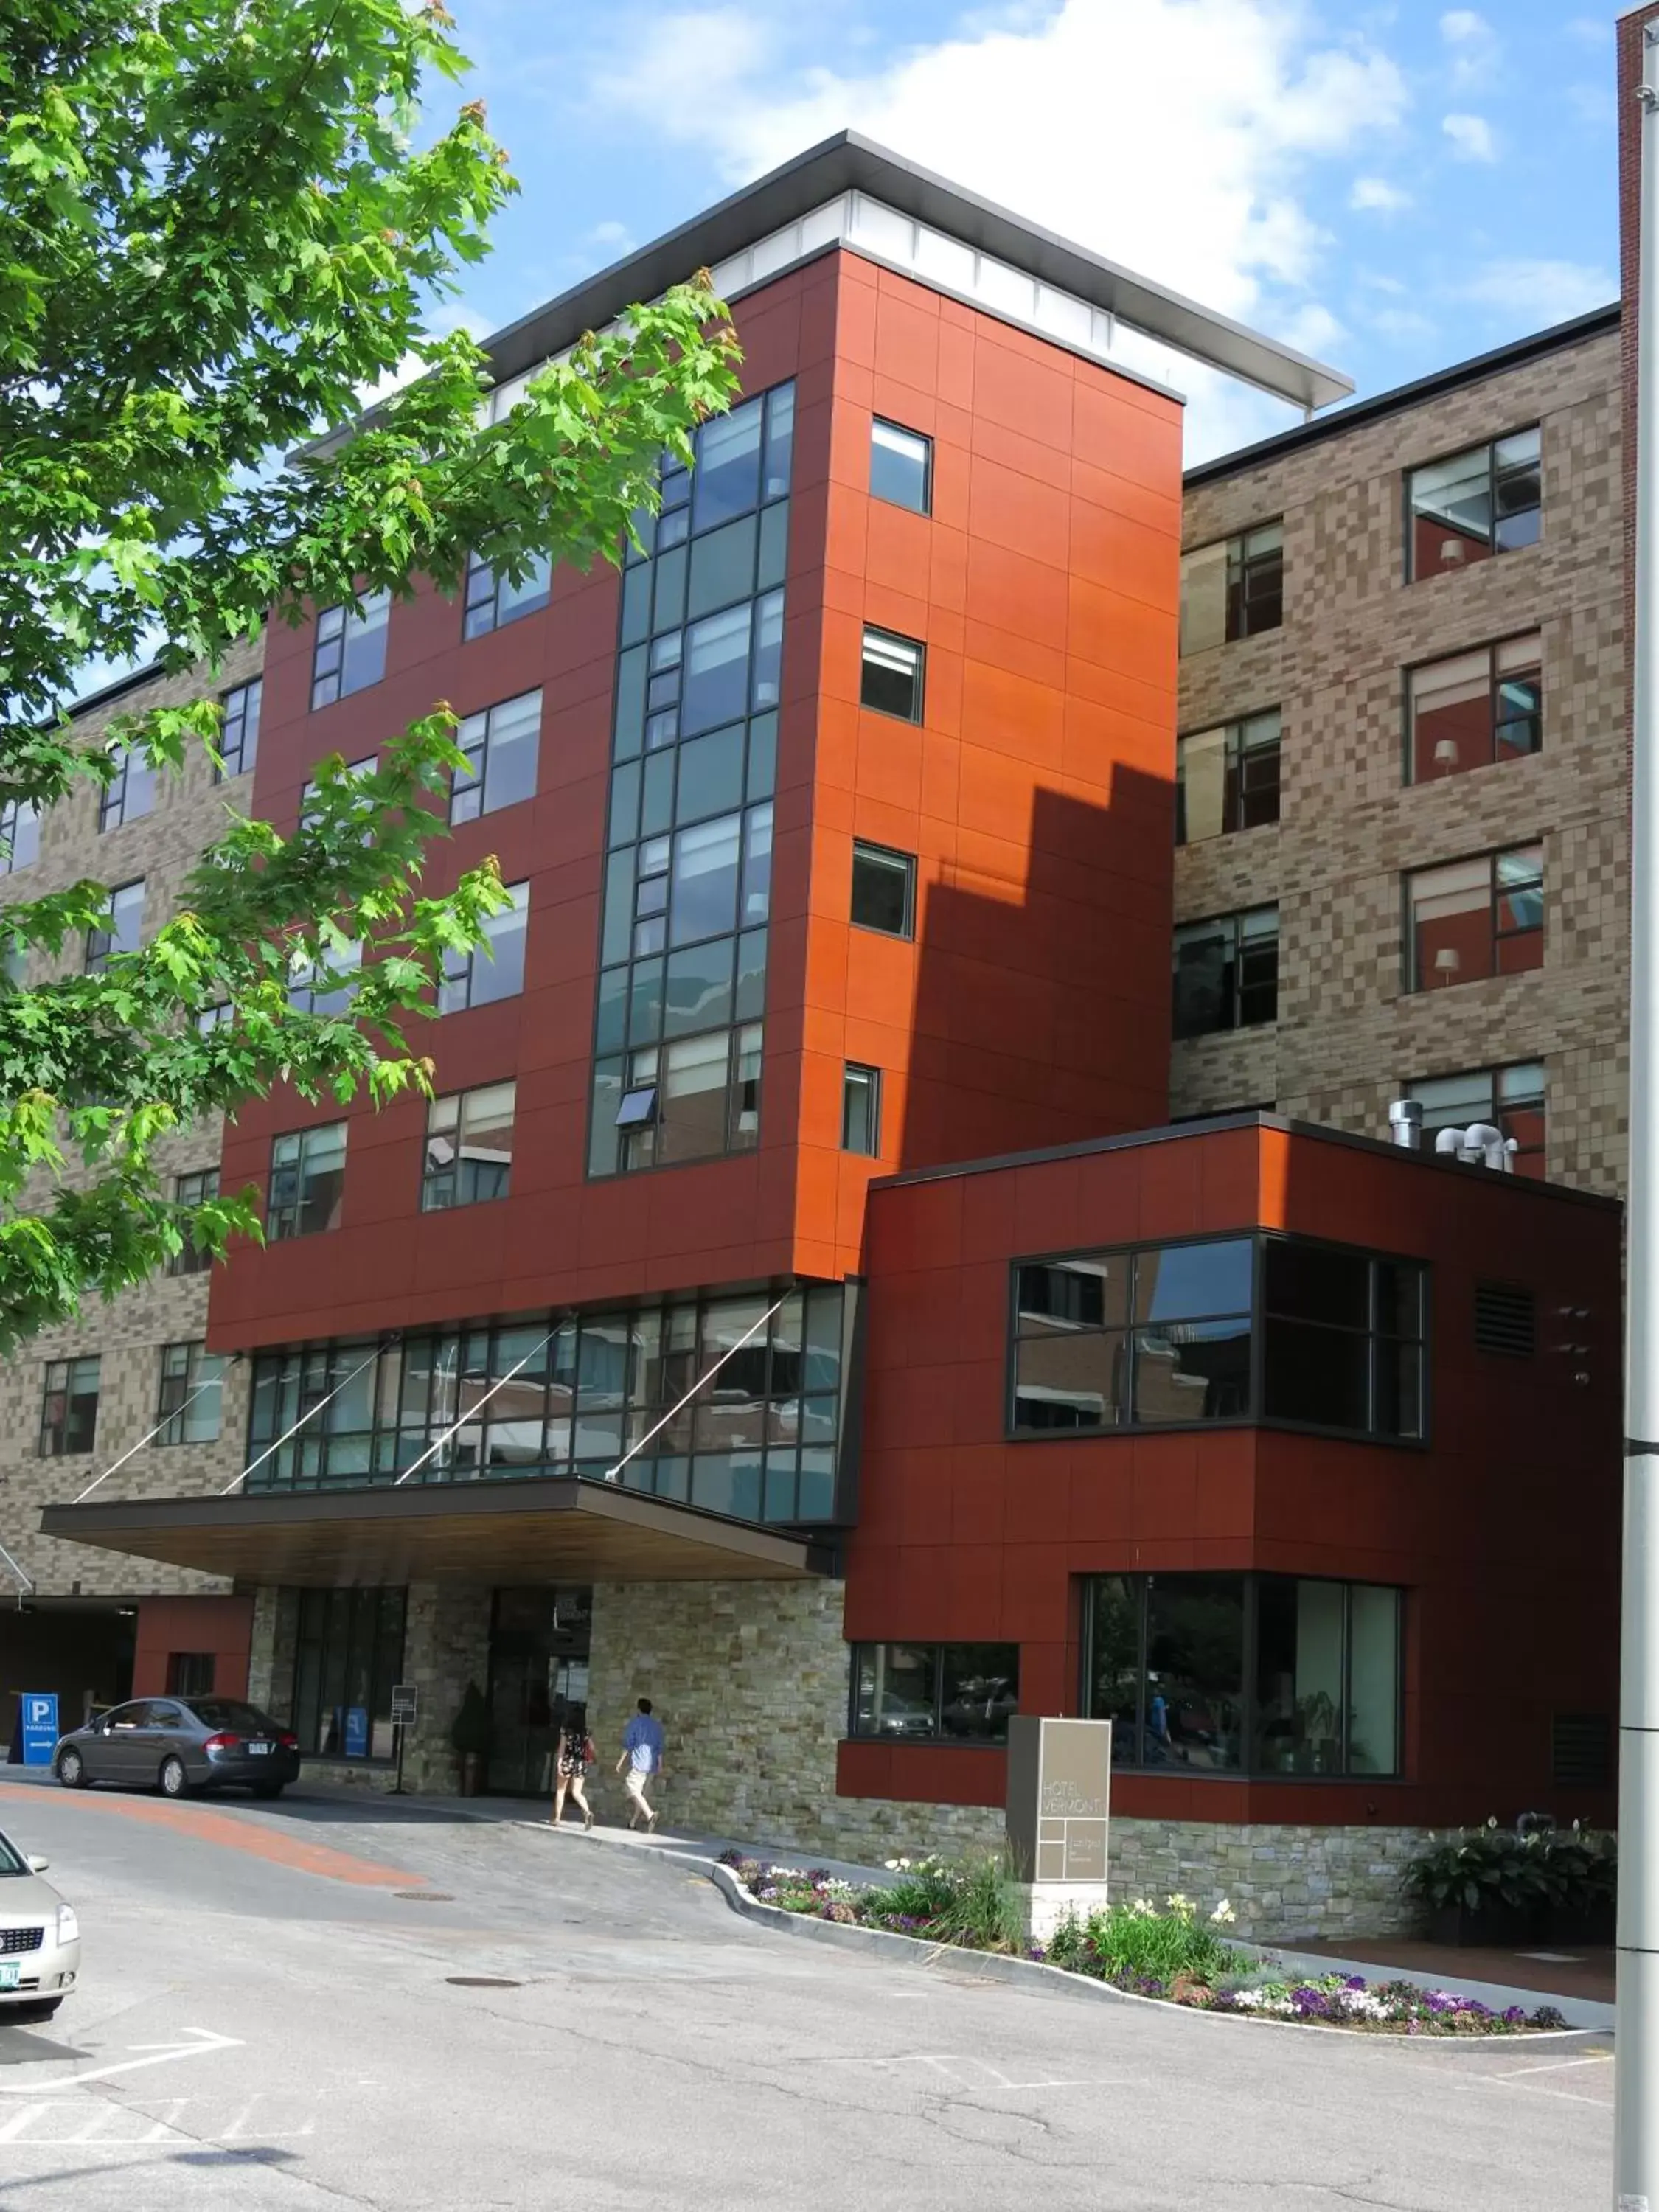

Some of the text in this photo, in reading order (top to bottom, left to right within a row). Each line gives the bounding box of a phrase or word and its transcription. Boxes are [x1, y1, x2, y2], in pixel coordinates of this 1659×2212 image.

[32, 1701, 49, 1722] P
[1043, 1781, 1081, 1797] HOTEL
[1042, 1799, 1101, 1815] VERMONT
